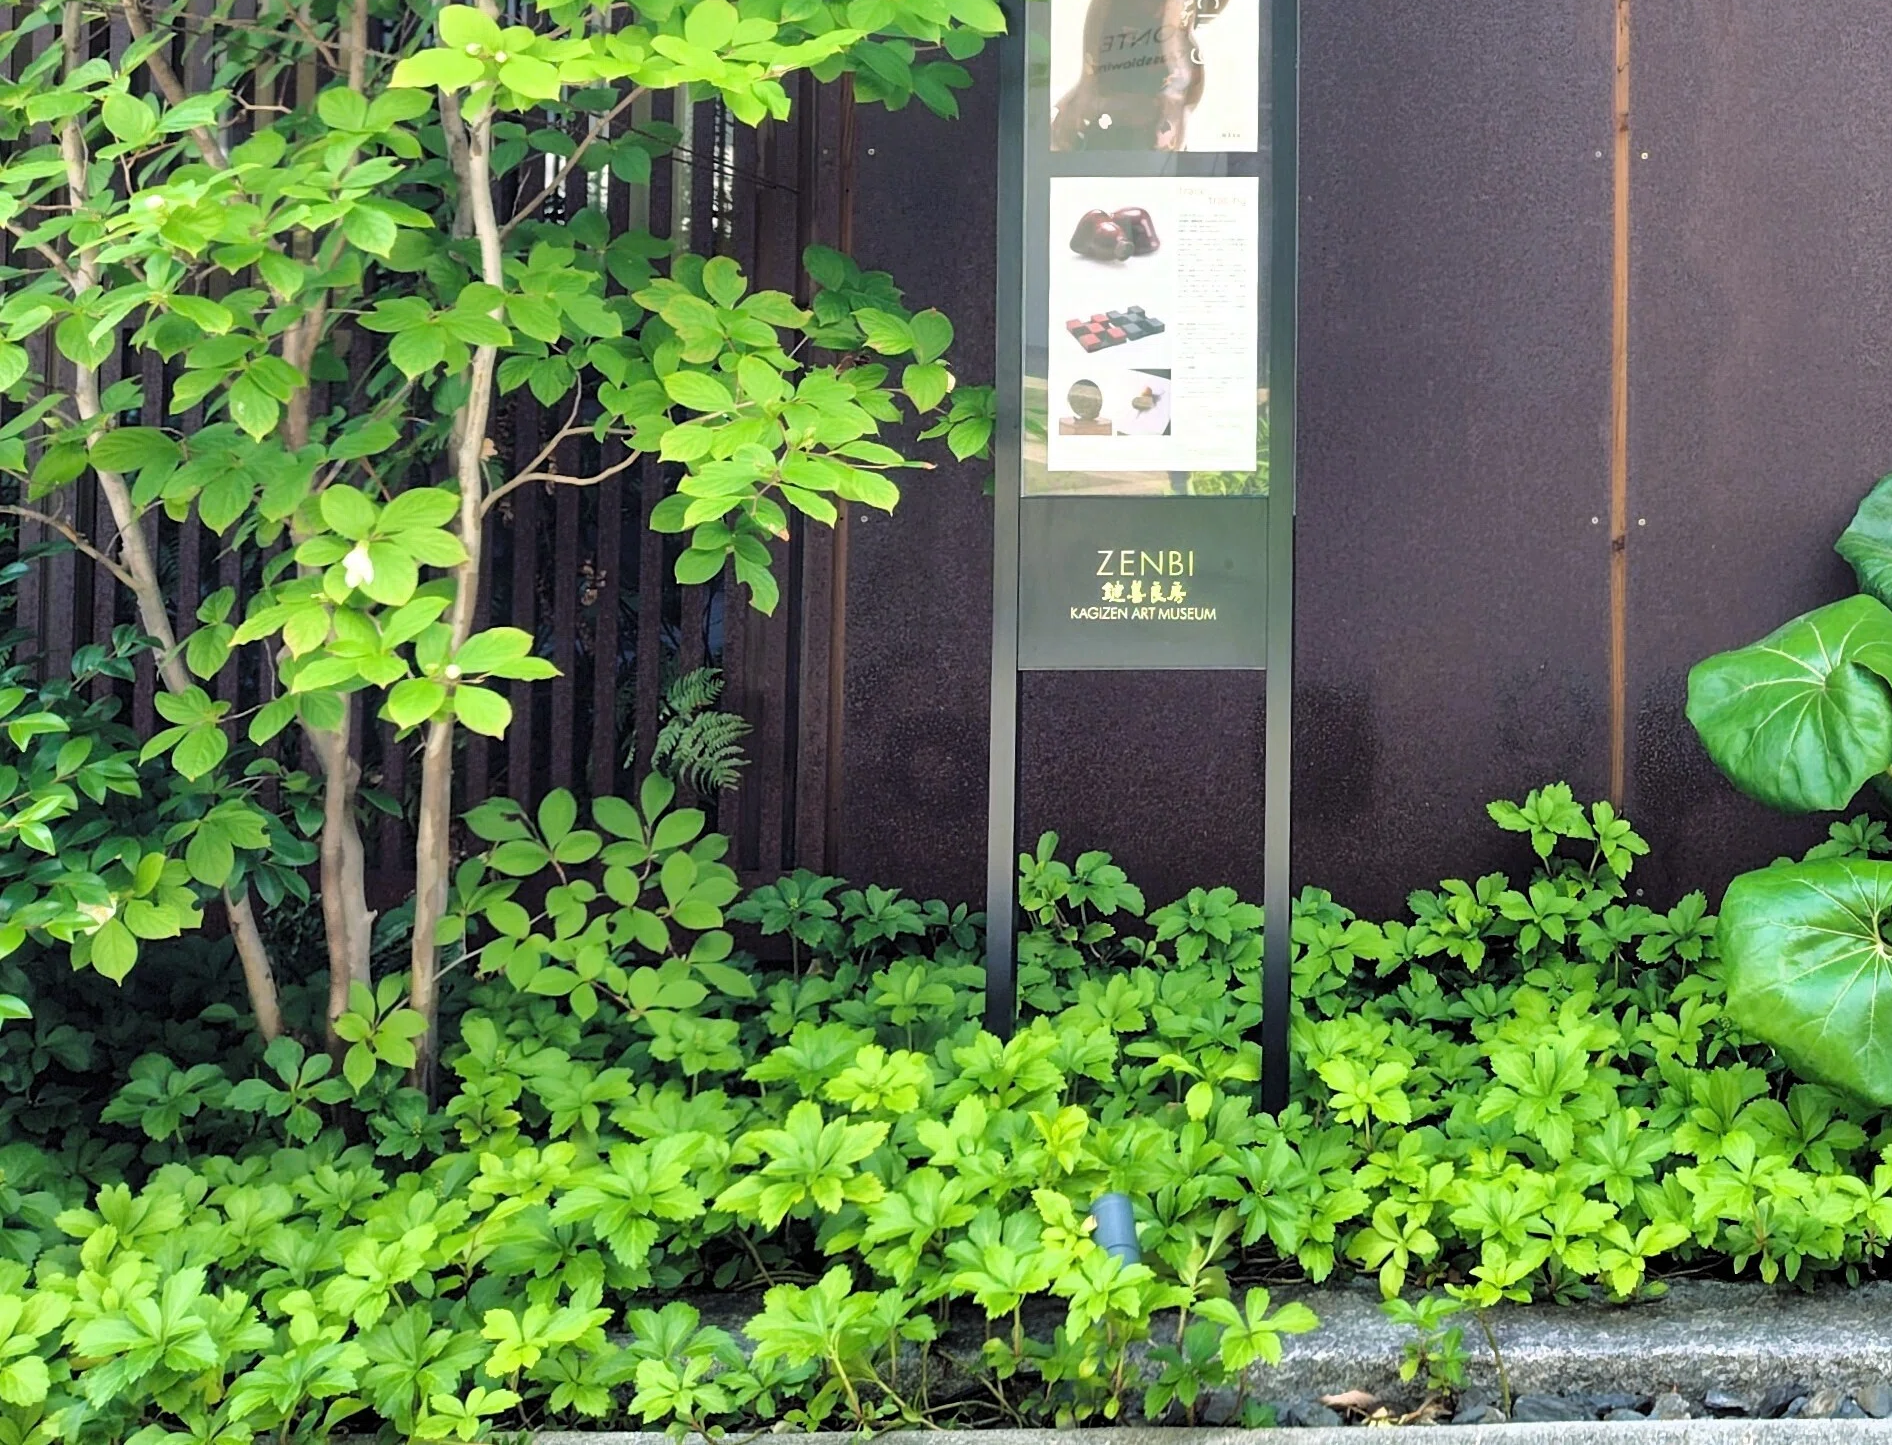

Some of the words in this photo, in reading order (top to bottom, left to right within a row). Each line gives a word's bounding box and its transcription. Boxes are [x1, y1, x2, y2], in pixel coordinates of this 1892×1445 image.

[1096, 550, 1194, 577] ZENBI
[1070, 606, 1128, 620] KAGIZEN
[1131, 607, 1156, 620] ART
[1157, 607, 1217, 621] MUSEUM
